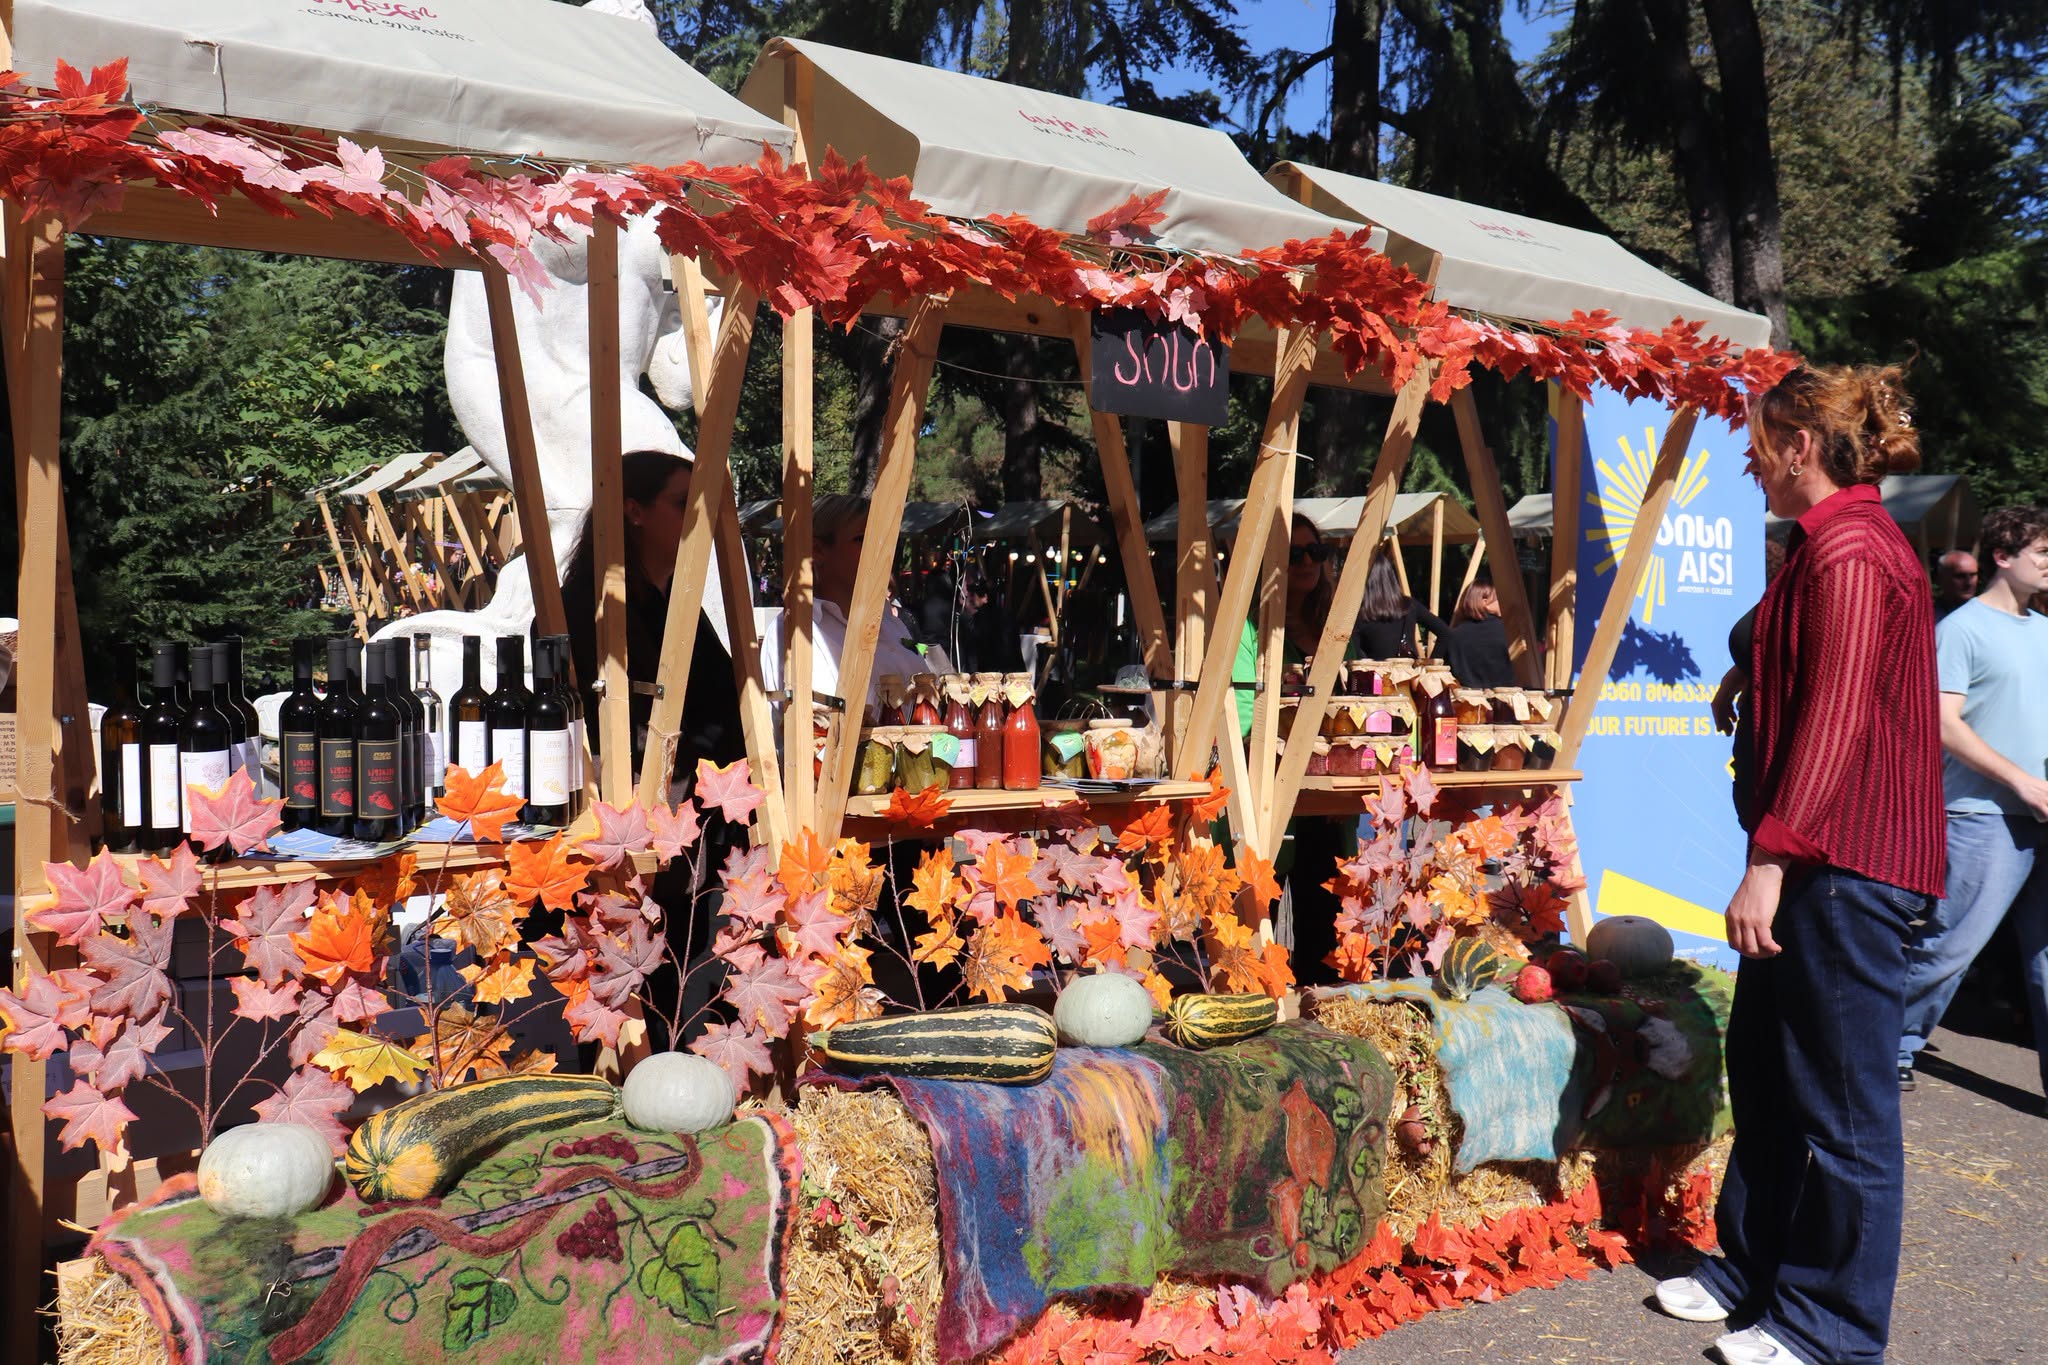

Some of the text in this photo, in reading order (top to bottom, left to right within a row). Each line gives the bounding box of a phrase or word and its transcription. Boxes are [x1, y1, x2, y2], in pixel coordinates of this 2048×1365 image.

[1114, 330, 1215, 391] აისი
[1655, 513, 1733, 550] აისი
[1677, 551, 1733, 585] AISI
[1625, 716, 1689, 736] FUTURE
[1694, 716, 1711, 736] IS
